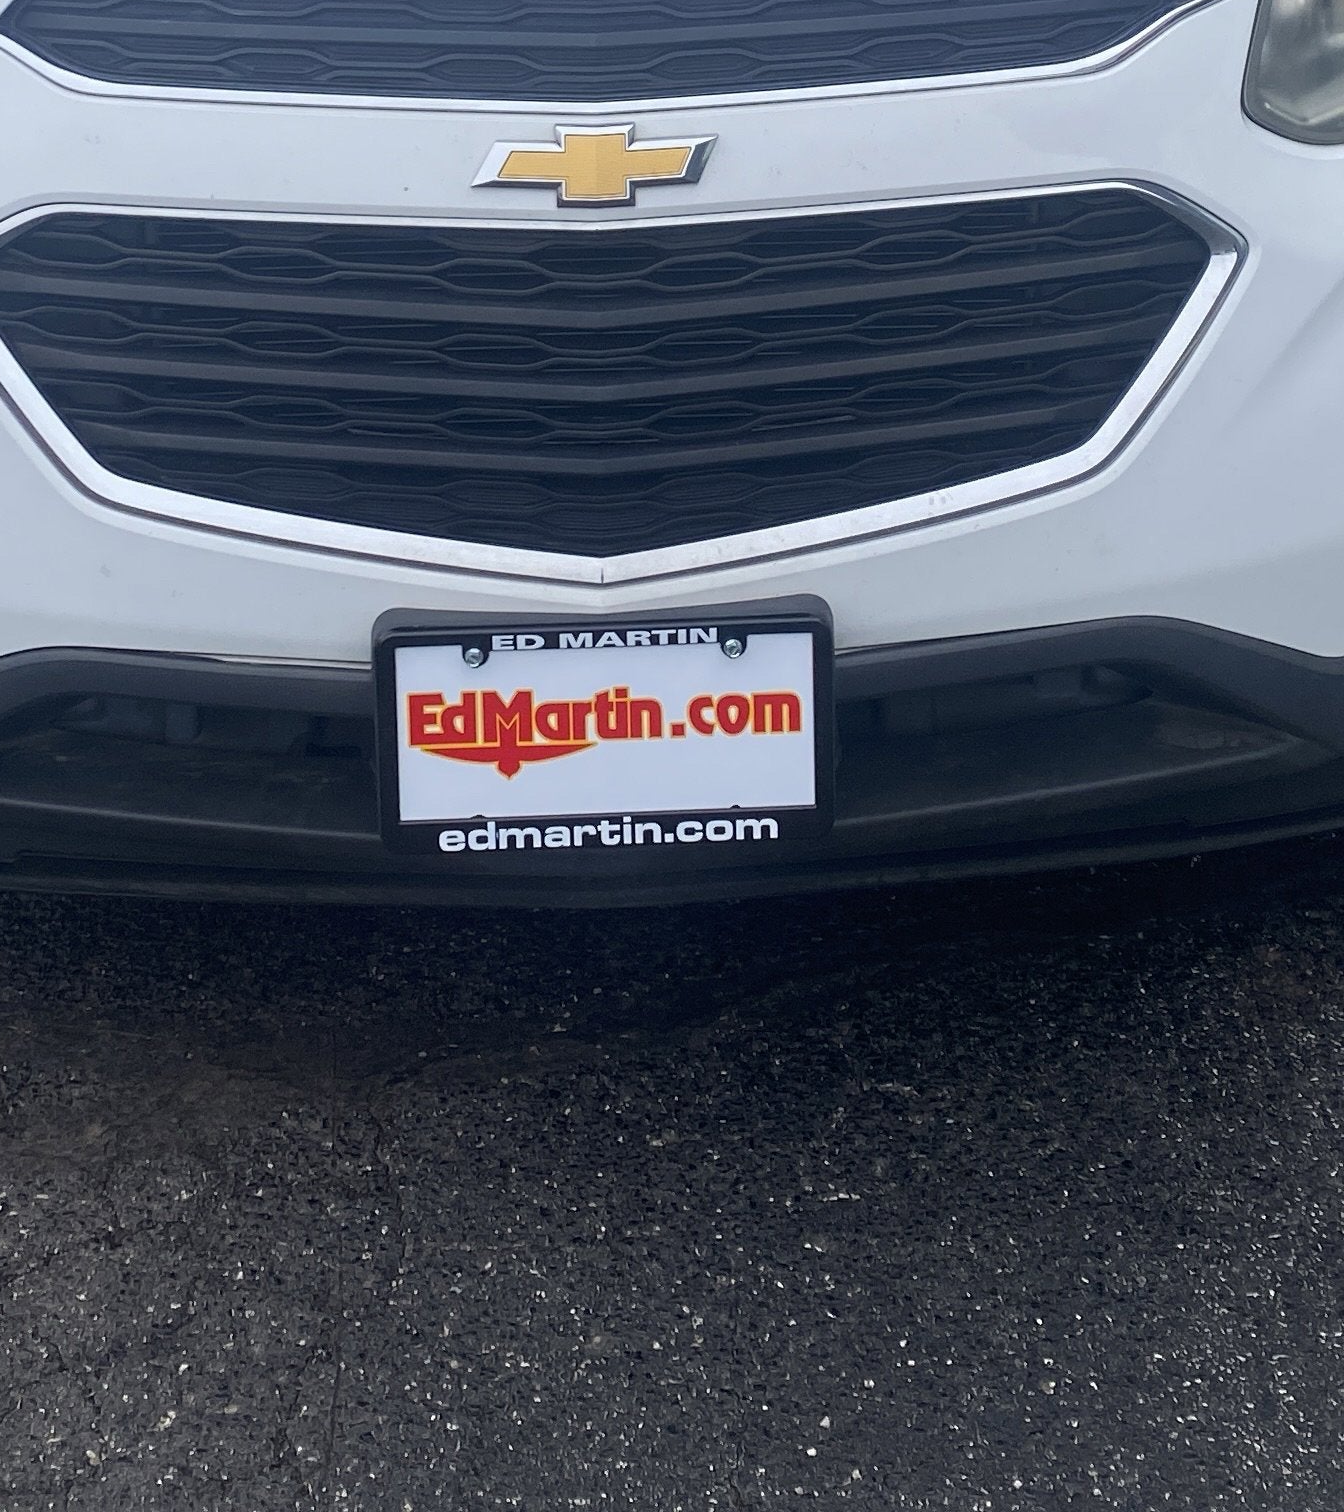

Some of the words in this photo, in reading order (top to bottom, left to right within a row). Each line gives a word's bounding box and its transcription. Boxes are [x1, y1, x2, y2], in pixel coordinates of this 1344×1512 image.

[491, 634, 545, 651] ED
[558, 627, 719, 649] MARTIN
[407, 686, 802, 749] EdMartin.com
[438, 816, 779, 852] edmartin.com
